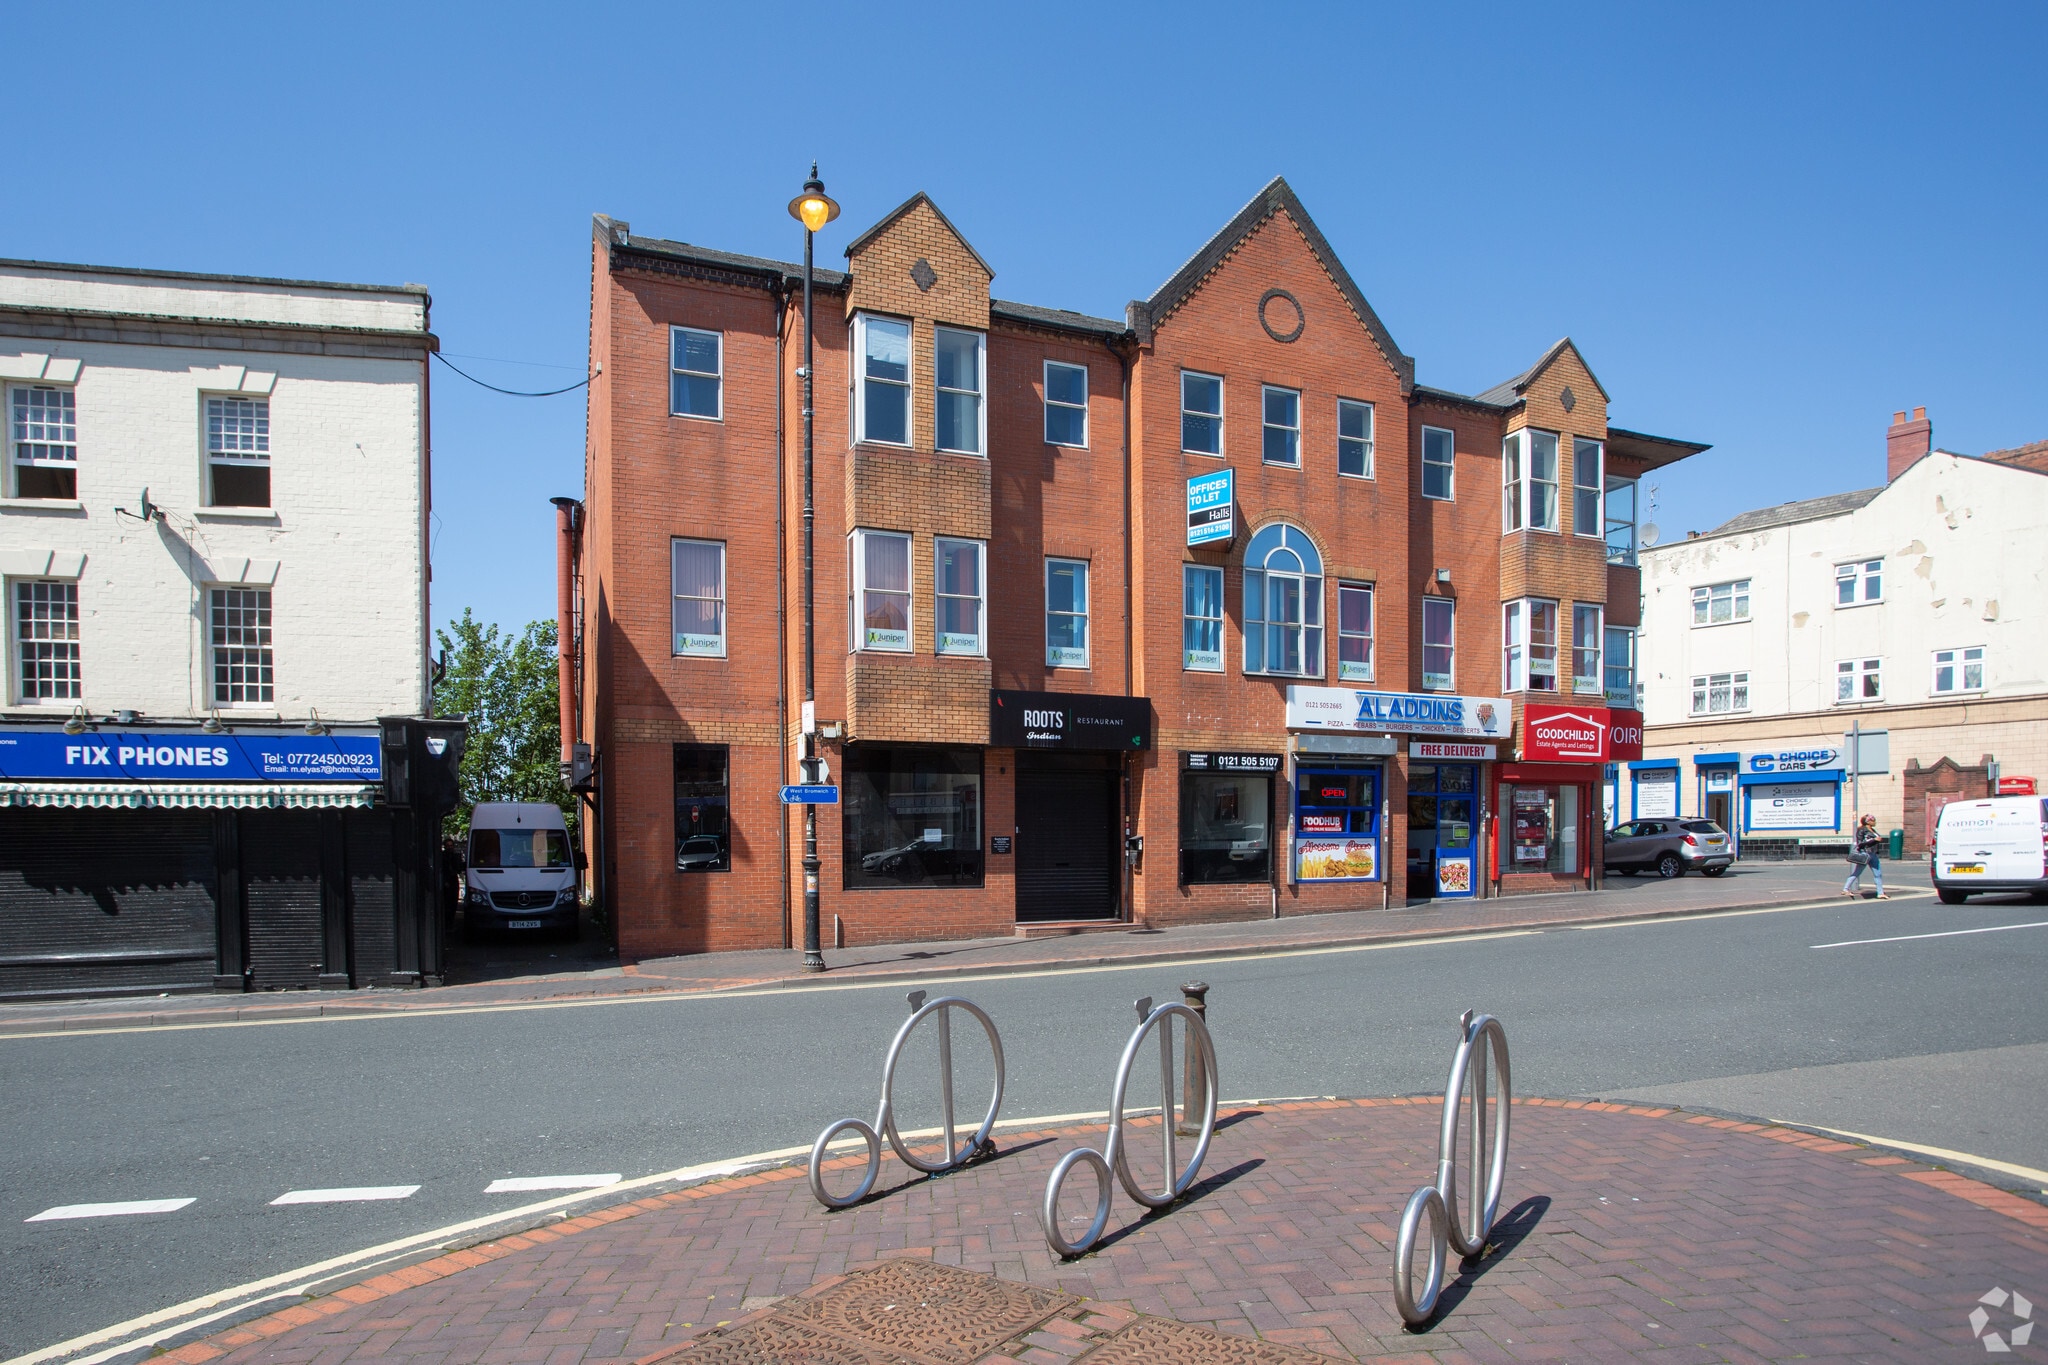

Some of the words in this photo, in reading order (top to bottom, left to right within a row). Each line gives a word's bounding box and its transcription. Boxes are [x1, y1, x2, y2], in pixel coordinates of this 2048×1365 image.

[1190, 478, 1227, 495] OFFICES
[1190, 495, 1201, 506] TO
[1203, 491, 1220, 503] LET
[1209, 508, 1230, 520] Halls
[690, 638, 718, 647] Juniper
[877, 632, 904, 643] Juniper
[950, 637, 976, 646] Juniper
[1059, 652, 1082, 660] Juniper
[1195, 655, 1217, 664] Juniper
[1348, 665, 1368, 674] Juniper
[1611, 690, 1629, 700] Juniper
[1358, 697, 1463, 721] ALADDINS
[1024, 709, 1063, 728] ROOTS
[1077, 717, 1124, 726] RESTAURANT
[1386, 723, 1413, 731] BURGERS
[1026, 731, 1062, 740] Indian
[1536, 727, 1595, 741] GOODCHILDS
[1421, 744, 1442, 756] FREE
[1444, 745, 1486, 757] DELIVERY
[1551, 741, 1567, 749] Agents
[1576, 742, 1594, 750] Lettings
[66, 746, 111, 765] FIX
[119, 746, 229, 766] PHONES
[261, 753, 284, 764] Tel:
[287, 753, 373, 765] 07724500923
[1779, 750, 1829, 762] CHOICE
[1218, 756, 1238, 765] 0121
[1241, 757, 1257, 766] 505
[1259, 757, 1279, 767] 5107
[1780, 762, 1806, 770] CARS
[264, 765, 288, 773] Email:
[291, 765, 379, 775] m.elyas7@hotmail.com
[1321, 789, 1345, 797] OPEN
[1303, 816, 1340, 826] FOODHUB
